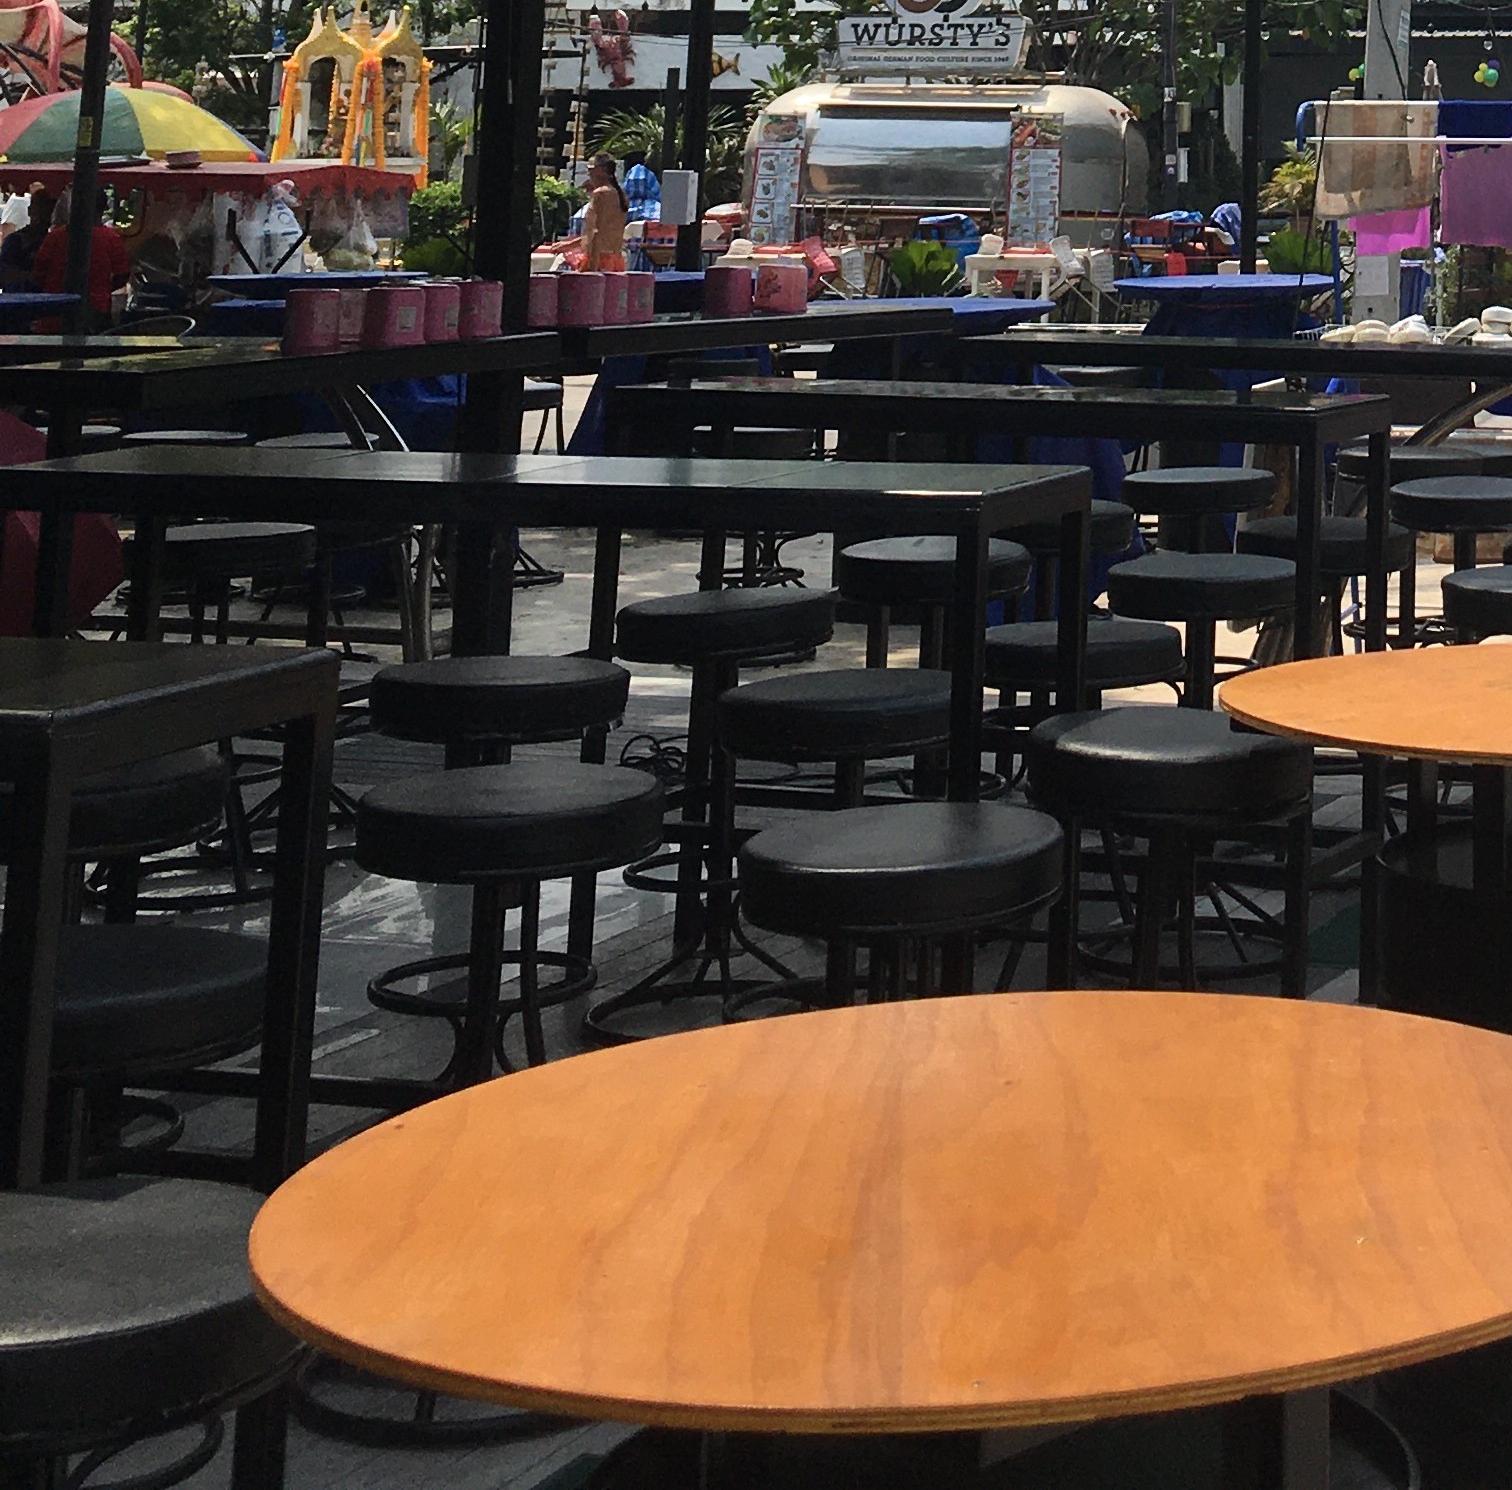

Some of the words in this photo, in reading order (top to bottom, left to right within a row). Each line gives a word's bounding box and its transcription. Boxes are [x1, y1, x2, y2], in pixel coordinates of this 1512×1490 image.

[915, 55, 935, 63] FOOD
[936, 55, 969, 63] CULTURE
[971, 55, 992, 63] SINCE
